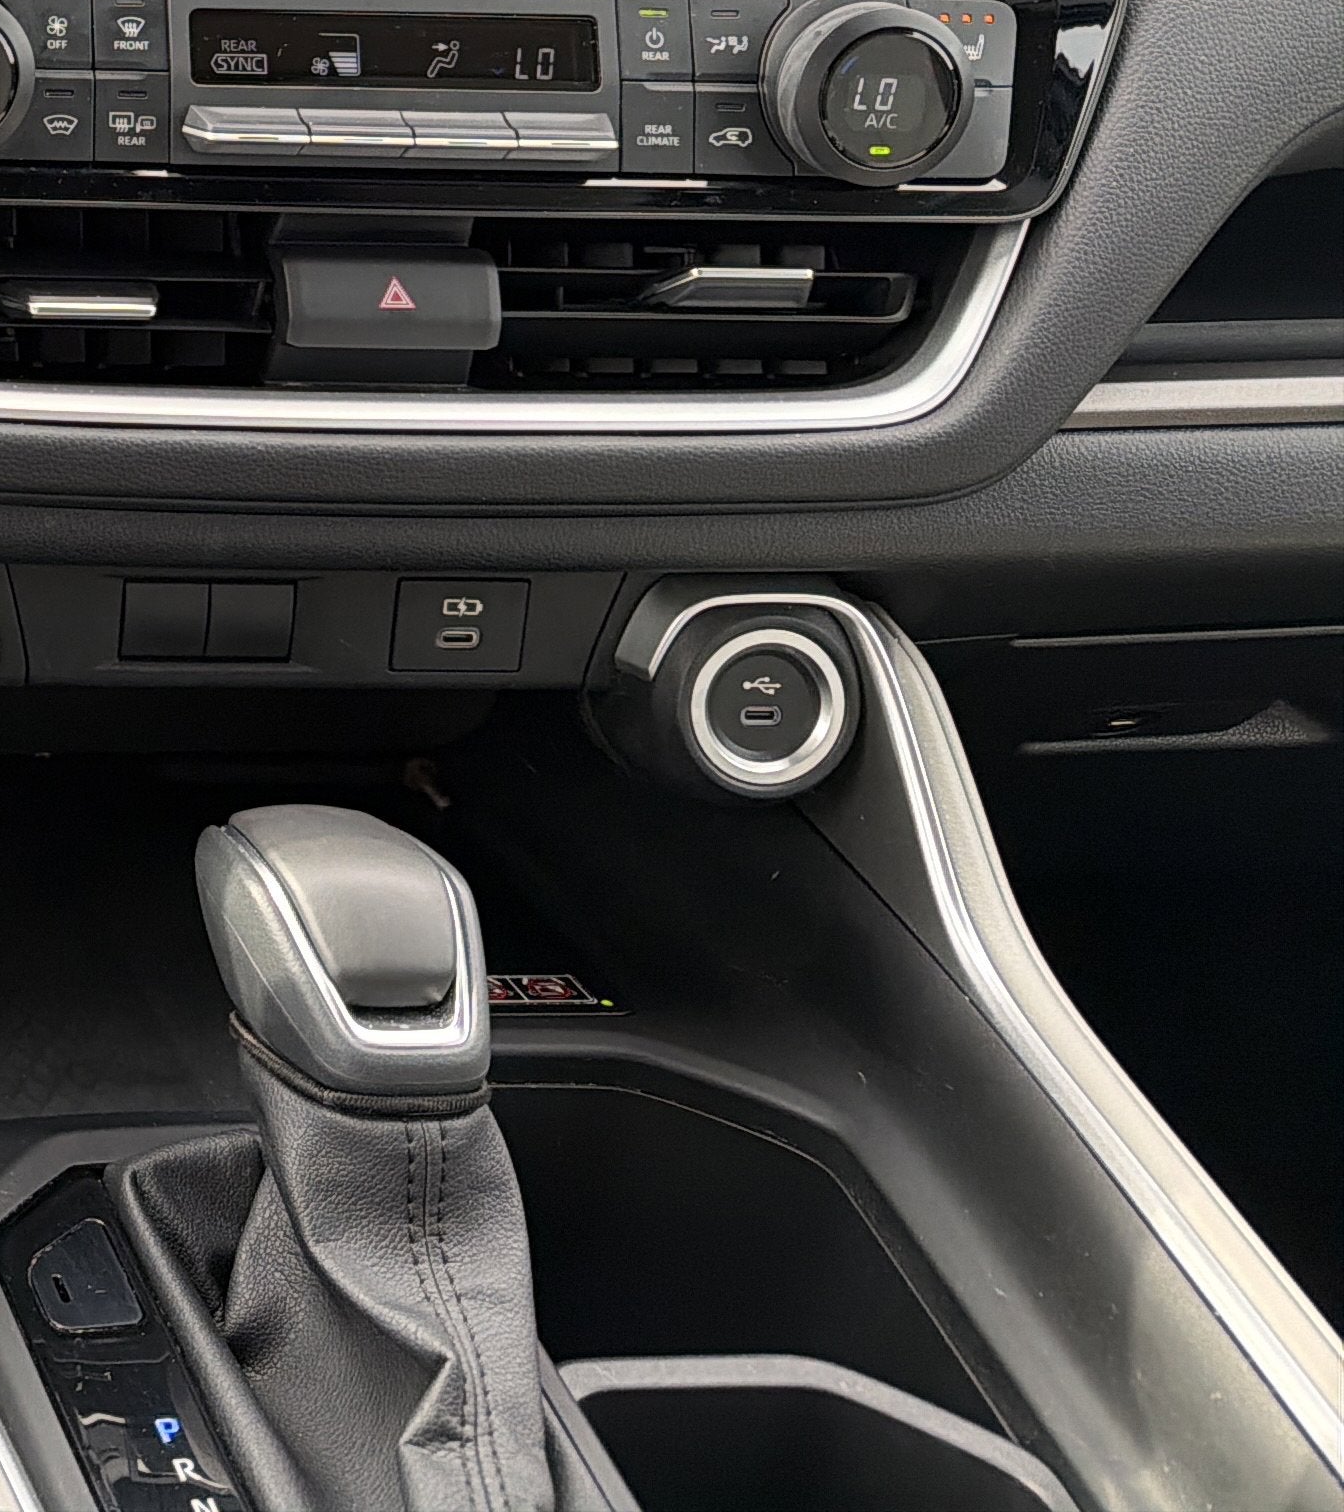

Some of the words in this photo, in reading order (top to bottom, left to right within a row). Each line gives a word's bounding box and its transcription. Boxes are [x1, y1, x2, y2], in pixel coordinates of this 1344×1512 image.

[46, 39, 68, 50] OFF
[113, 40, 150, 51] FRONT
[220, 39, 258, 52] REAR
[641, 51, 670, 61] REAR
[216, 55, 263, 72] SYNC
[514, 46, 555, 81] LO
[852, 77, 898, 111] LO
[864, 112, 898, 130] A/C
[644, 124, 673, 135] REAR
[117, 136, 147, 146] REAR
[636, 135, 681, 147] CLIMATE
[154, 1417, 181, 1444] P
[172, 1458, 203, 1483] R
